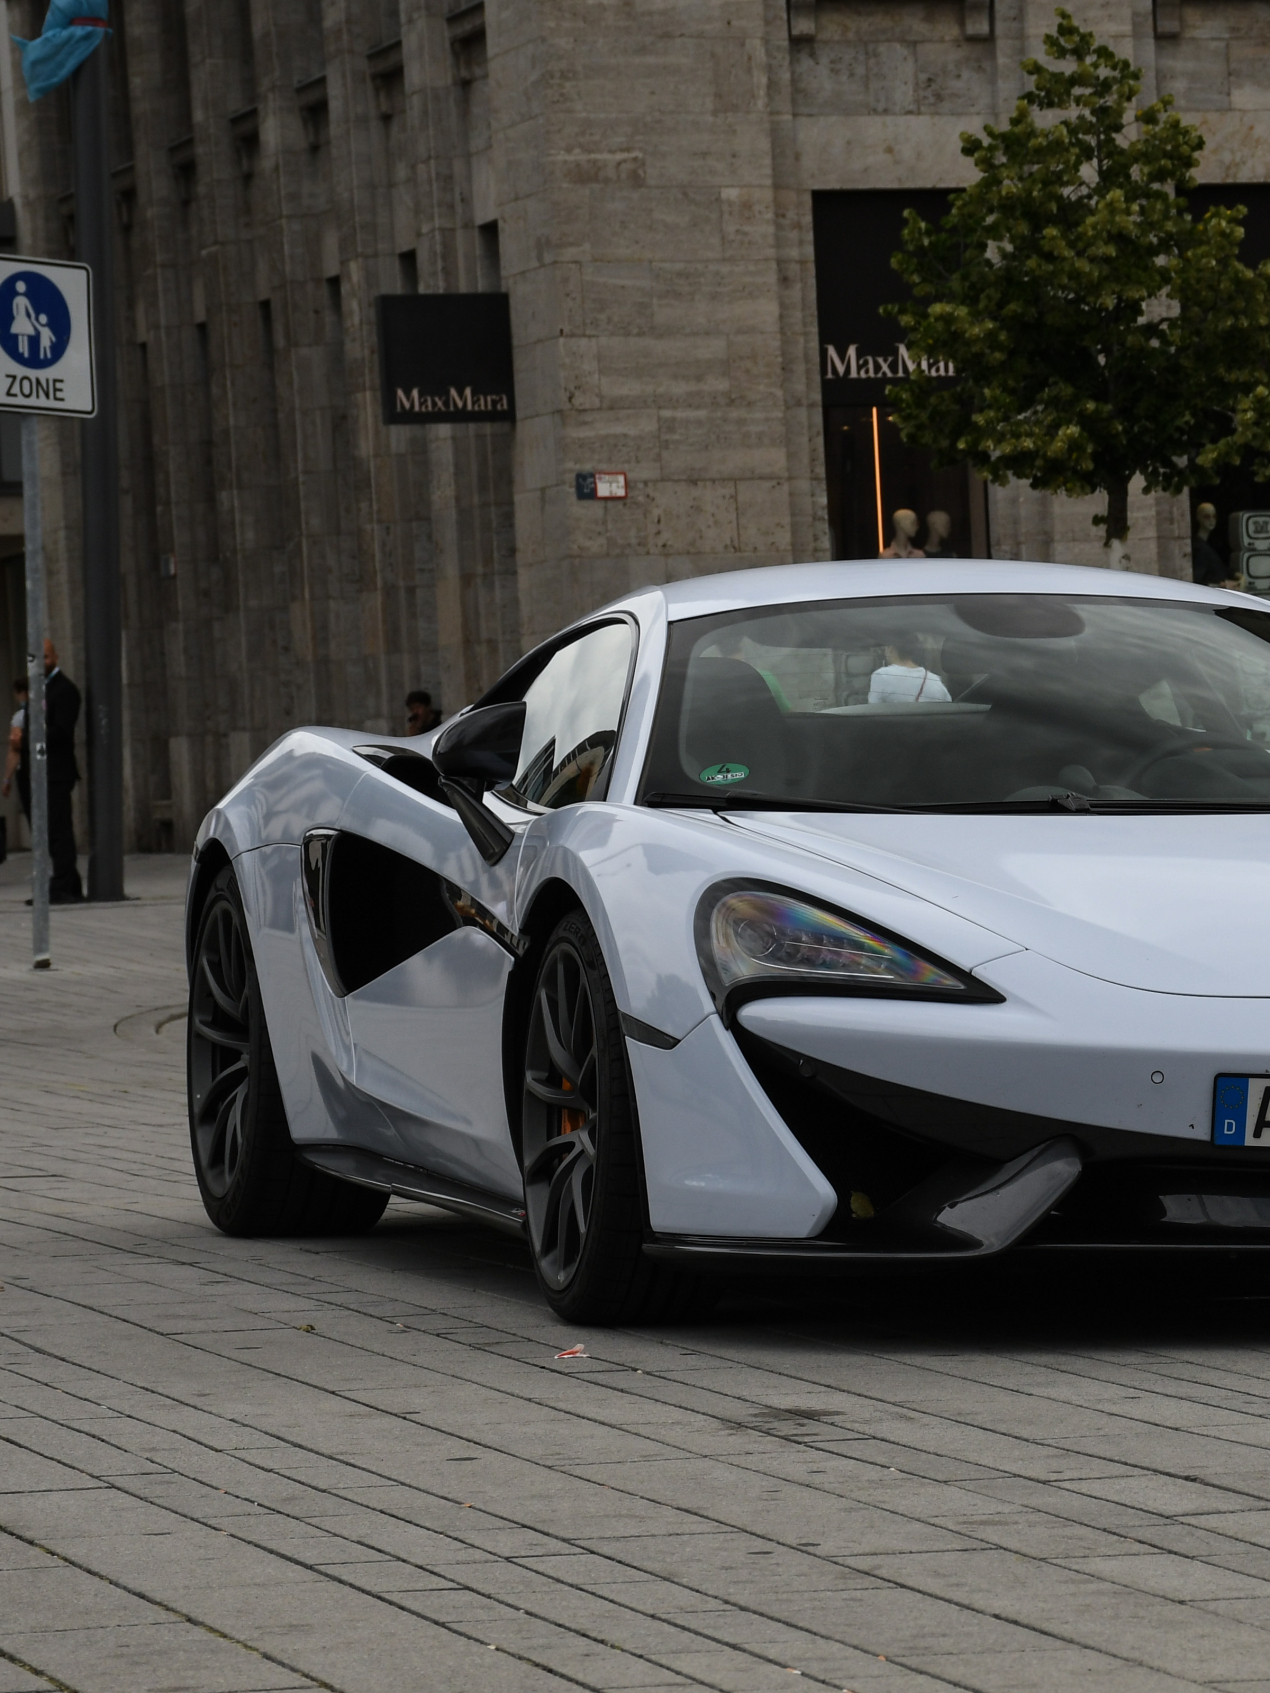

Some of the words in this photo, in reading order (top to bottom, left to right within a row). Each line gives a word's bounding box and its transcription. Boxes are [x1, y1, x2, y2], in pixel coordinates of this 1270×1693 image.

[823, 342, 956, 379] MaxMar
[5, 374, 65, 402] ZONE
[396, 386, 509, 413] MaxMara
[717, 763, 731, 774] 4
[1224, 1119, 1236, 1135] D
